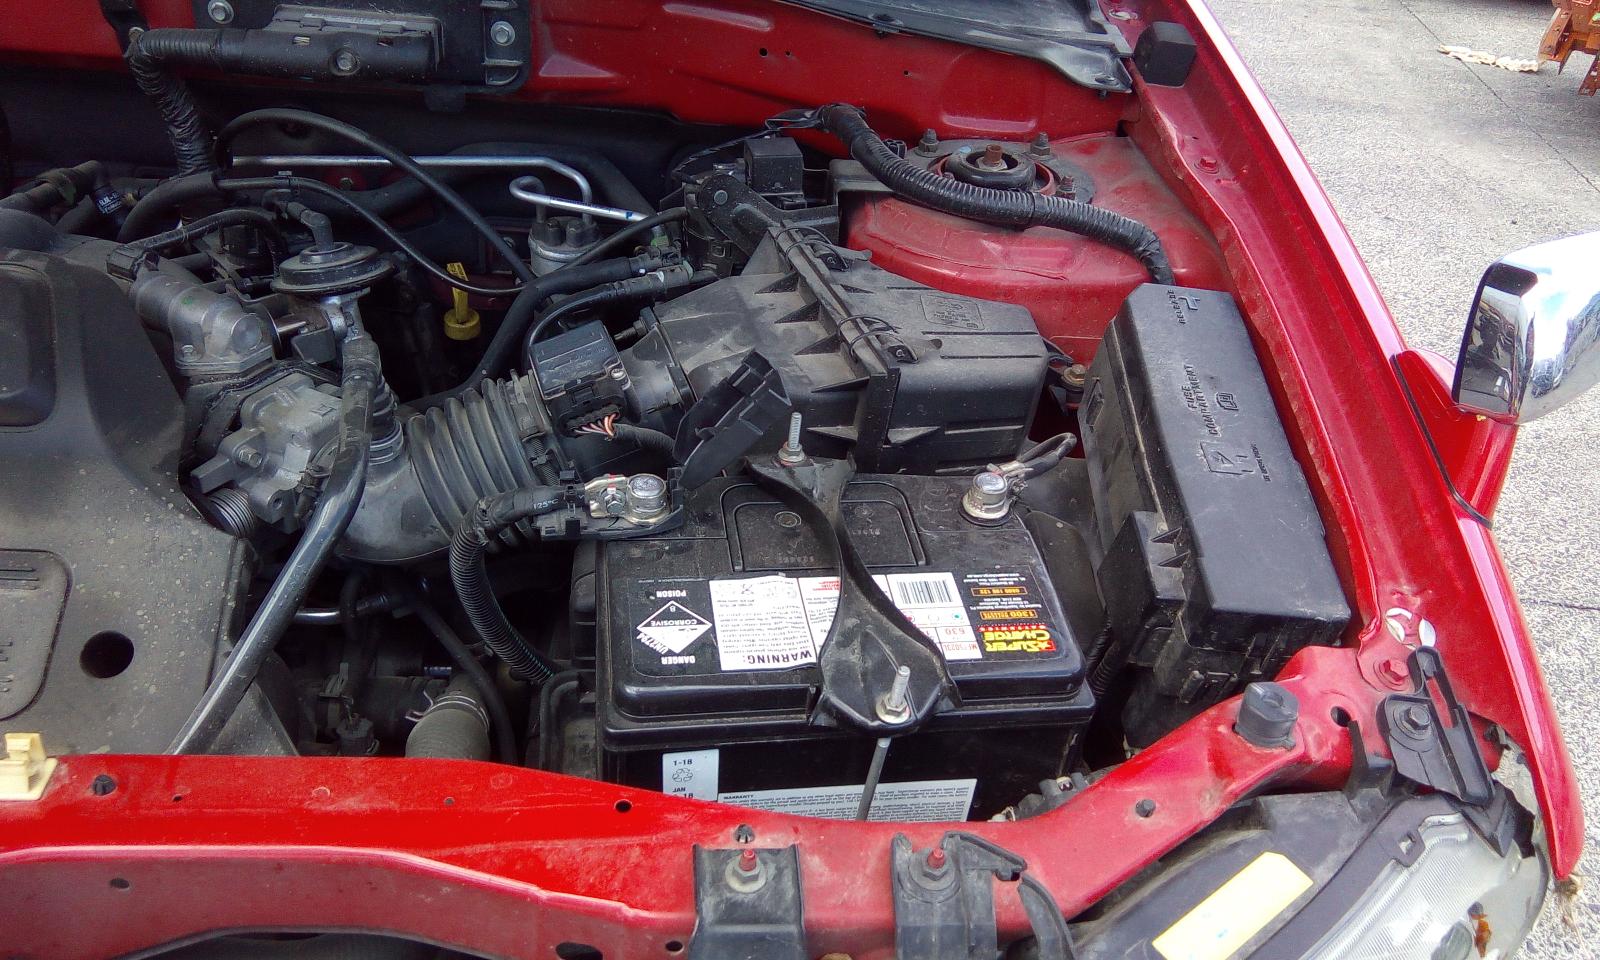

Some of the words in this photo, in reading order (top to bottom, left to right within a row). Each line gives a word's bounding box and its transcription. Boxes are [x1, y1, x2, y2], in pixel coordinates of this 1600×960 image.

[1182, 386, 1198, 410] FUSE
[1184, 364, 1220, 436] COMPARTMENT
[656, 590, 687, 598] POISON
[650, 619, 698, 627] CORROSIVE
[983, 629, 1051, 641] CHARGE
[984, 640, 1042, 652] SUPER
[661, 655, 696, 665] DANGER
[742, 650, 812, 665] WARNING:
